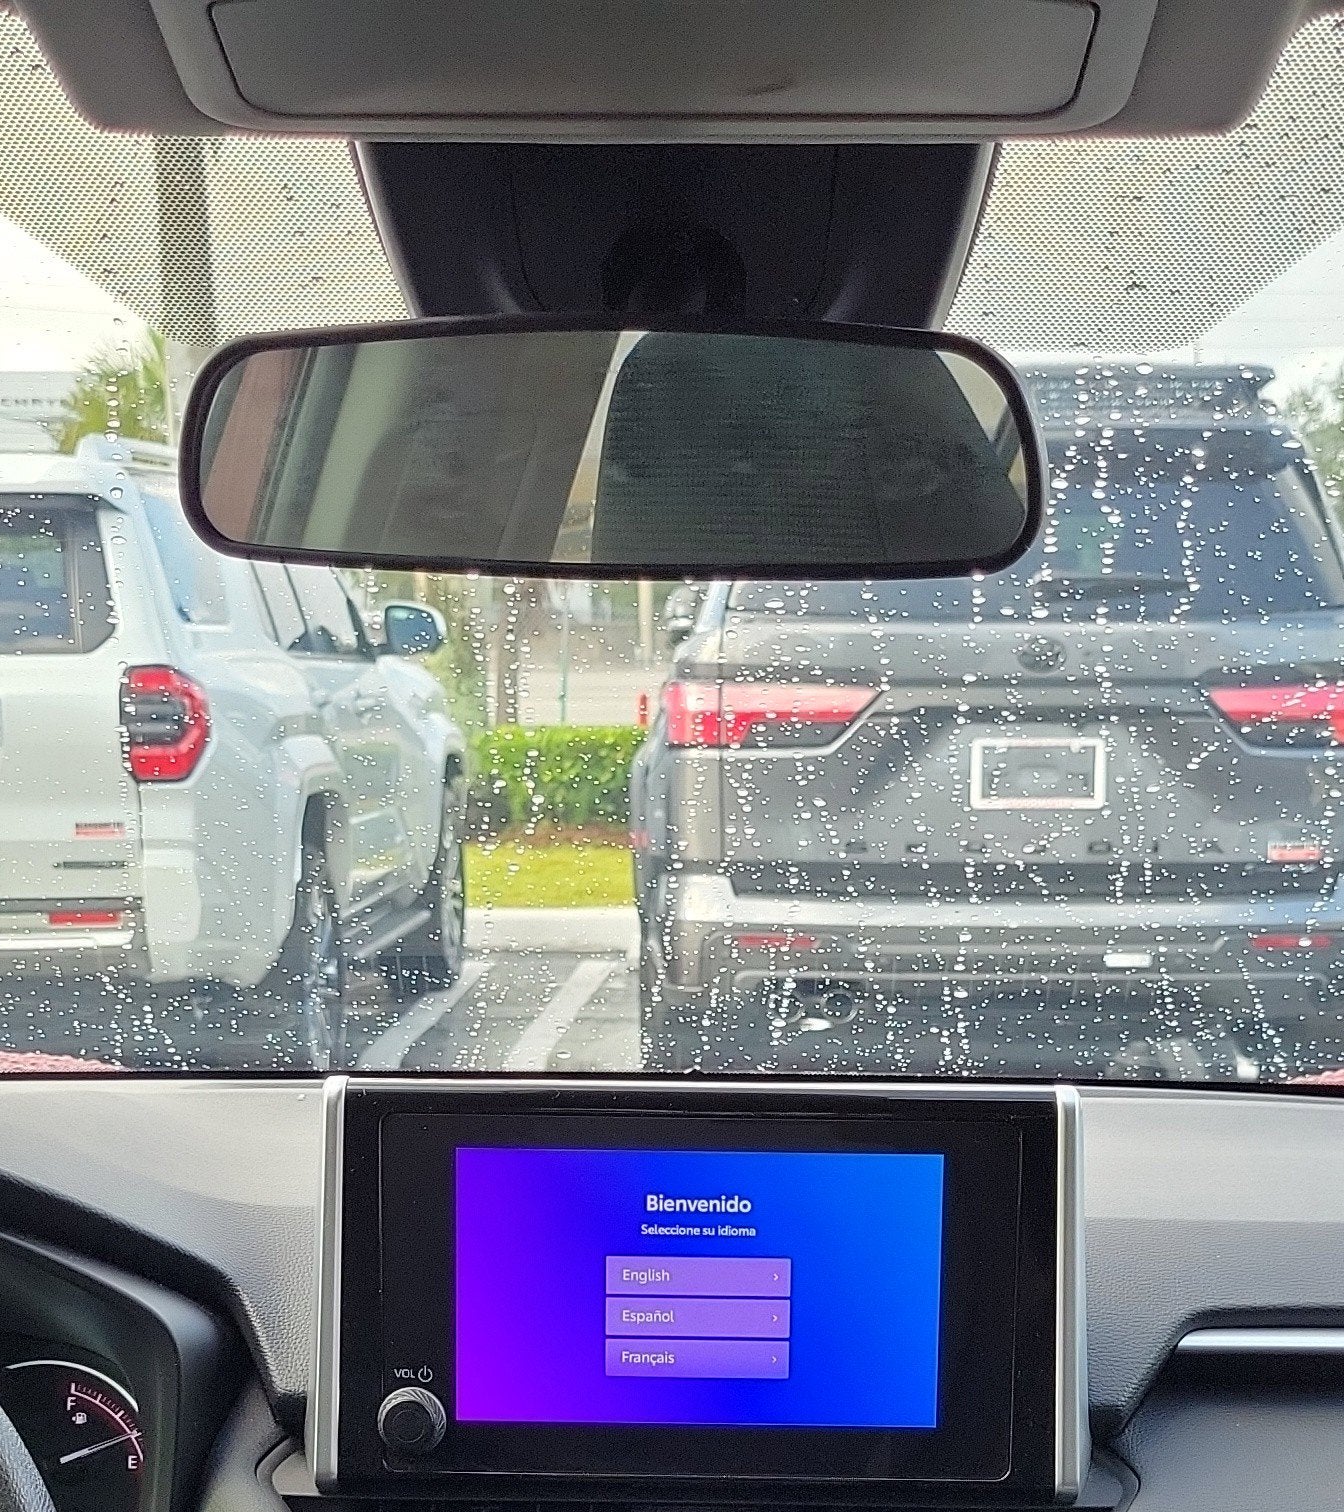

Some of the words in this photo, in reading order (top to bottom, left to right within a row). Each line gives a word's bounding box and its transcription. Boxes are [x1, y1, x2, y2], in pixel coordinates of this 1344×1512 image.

[646, 1194, 752, 1213] Bienvenido
[641, 1224, 700, 1236] Seleccione
[702, 1227, 715, 1236] su
[718, 1225, 756, 1237] idioma
[622, 1269, 670, 1284] English
[622, 1310, 674, 1324] Español
[621, 1351, 675, 1366] Français
[394, 1369, 415, 1378] VOL
[67, 1397, 76, 1411] F
[128, 1456, 137, 1469] E
